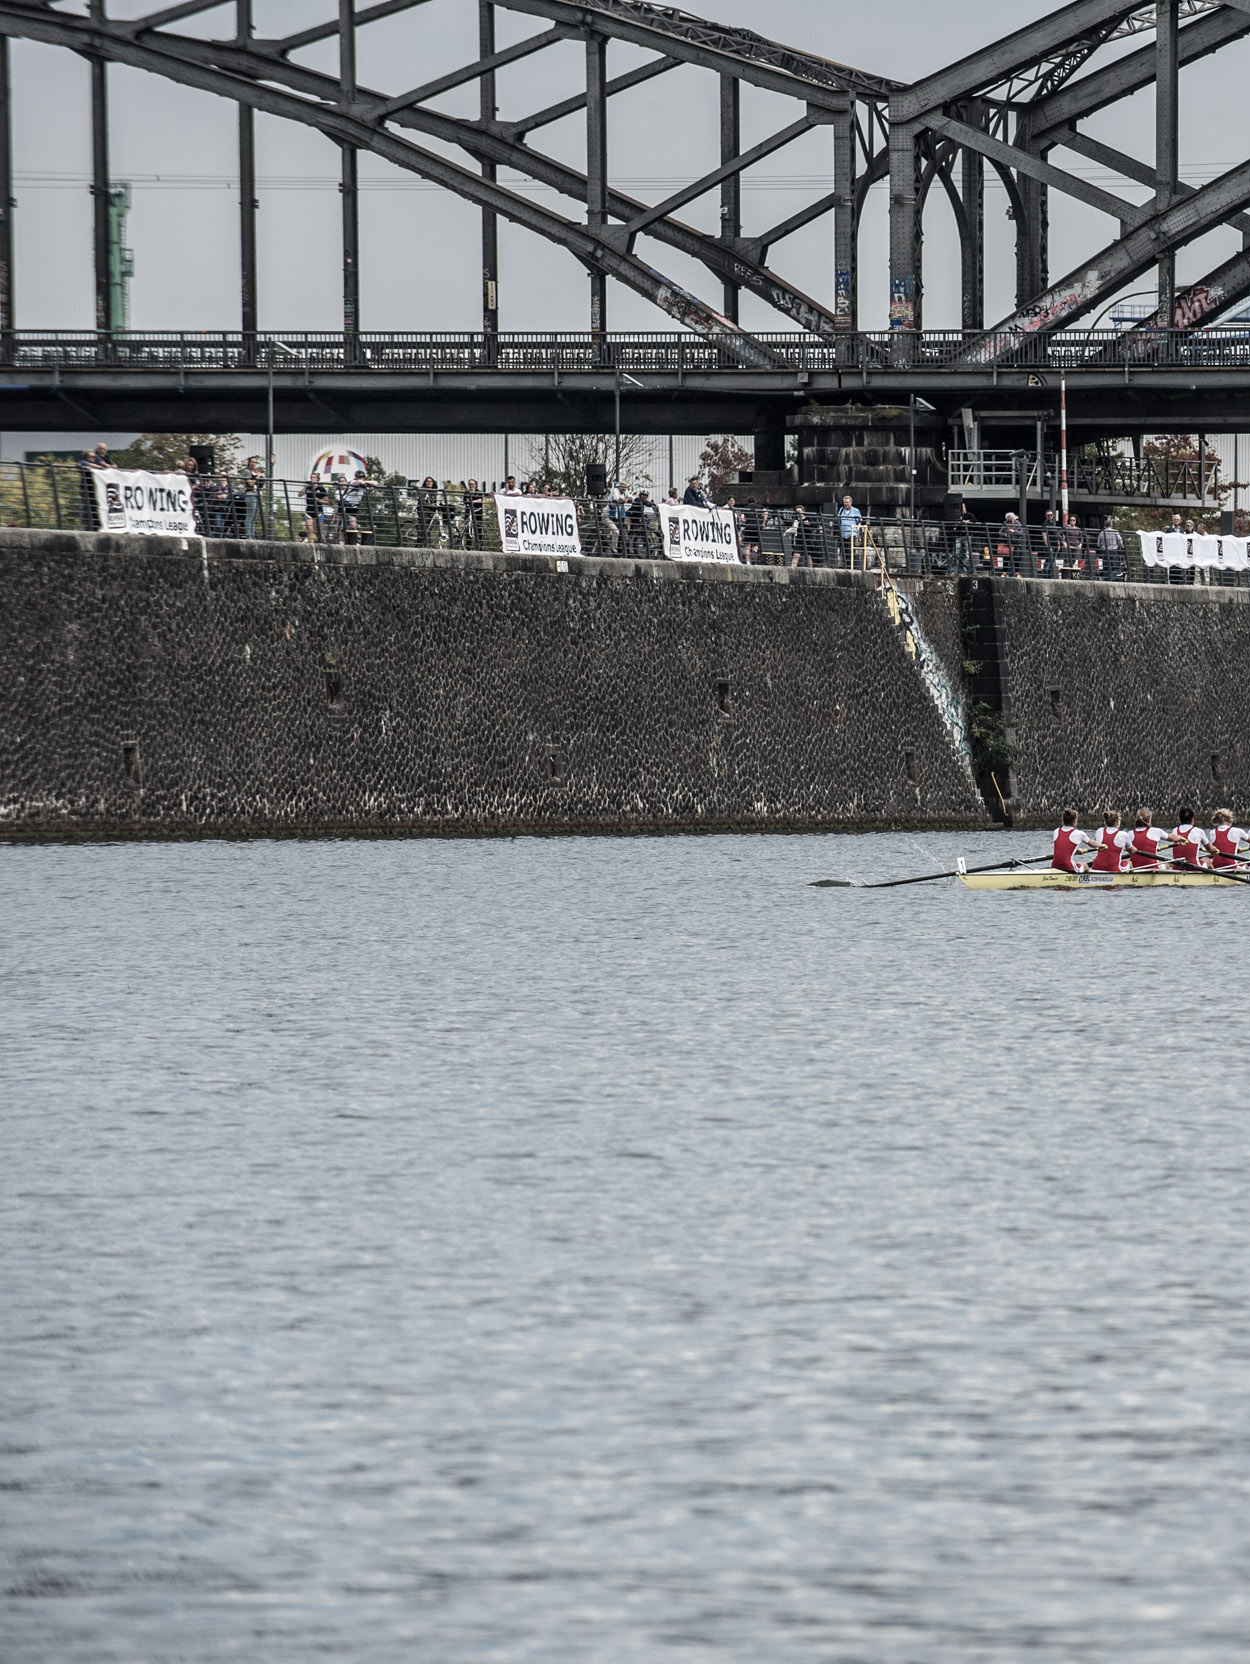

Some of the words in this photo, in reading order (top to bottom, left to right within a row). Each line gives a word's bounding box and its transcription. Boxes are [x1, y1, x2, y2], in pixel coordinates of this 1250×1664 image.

[124, 486, 188, 513] ROWING
[520, 511, 574, 536] ROWING
[682, 518, 732, 545] ROWING
[522, 539, 555, 553] Champions
[555, 541, 577, 555] League
[716, 548, 735, 563] League
[972, 580, 979, 590] 3
